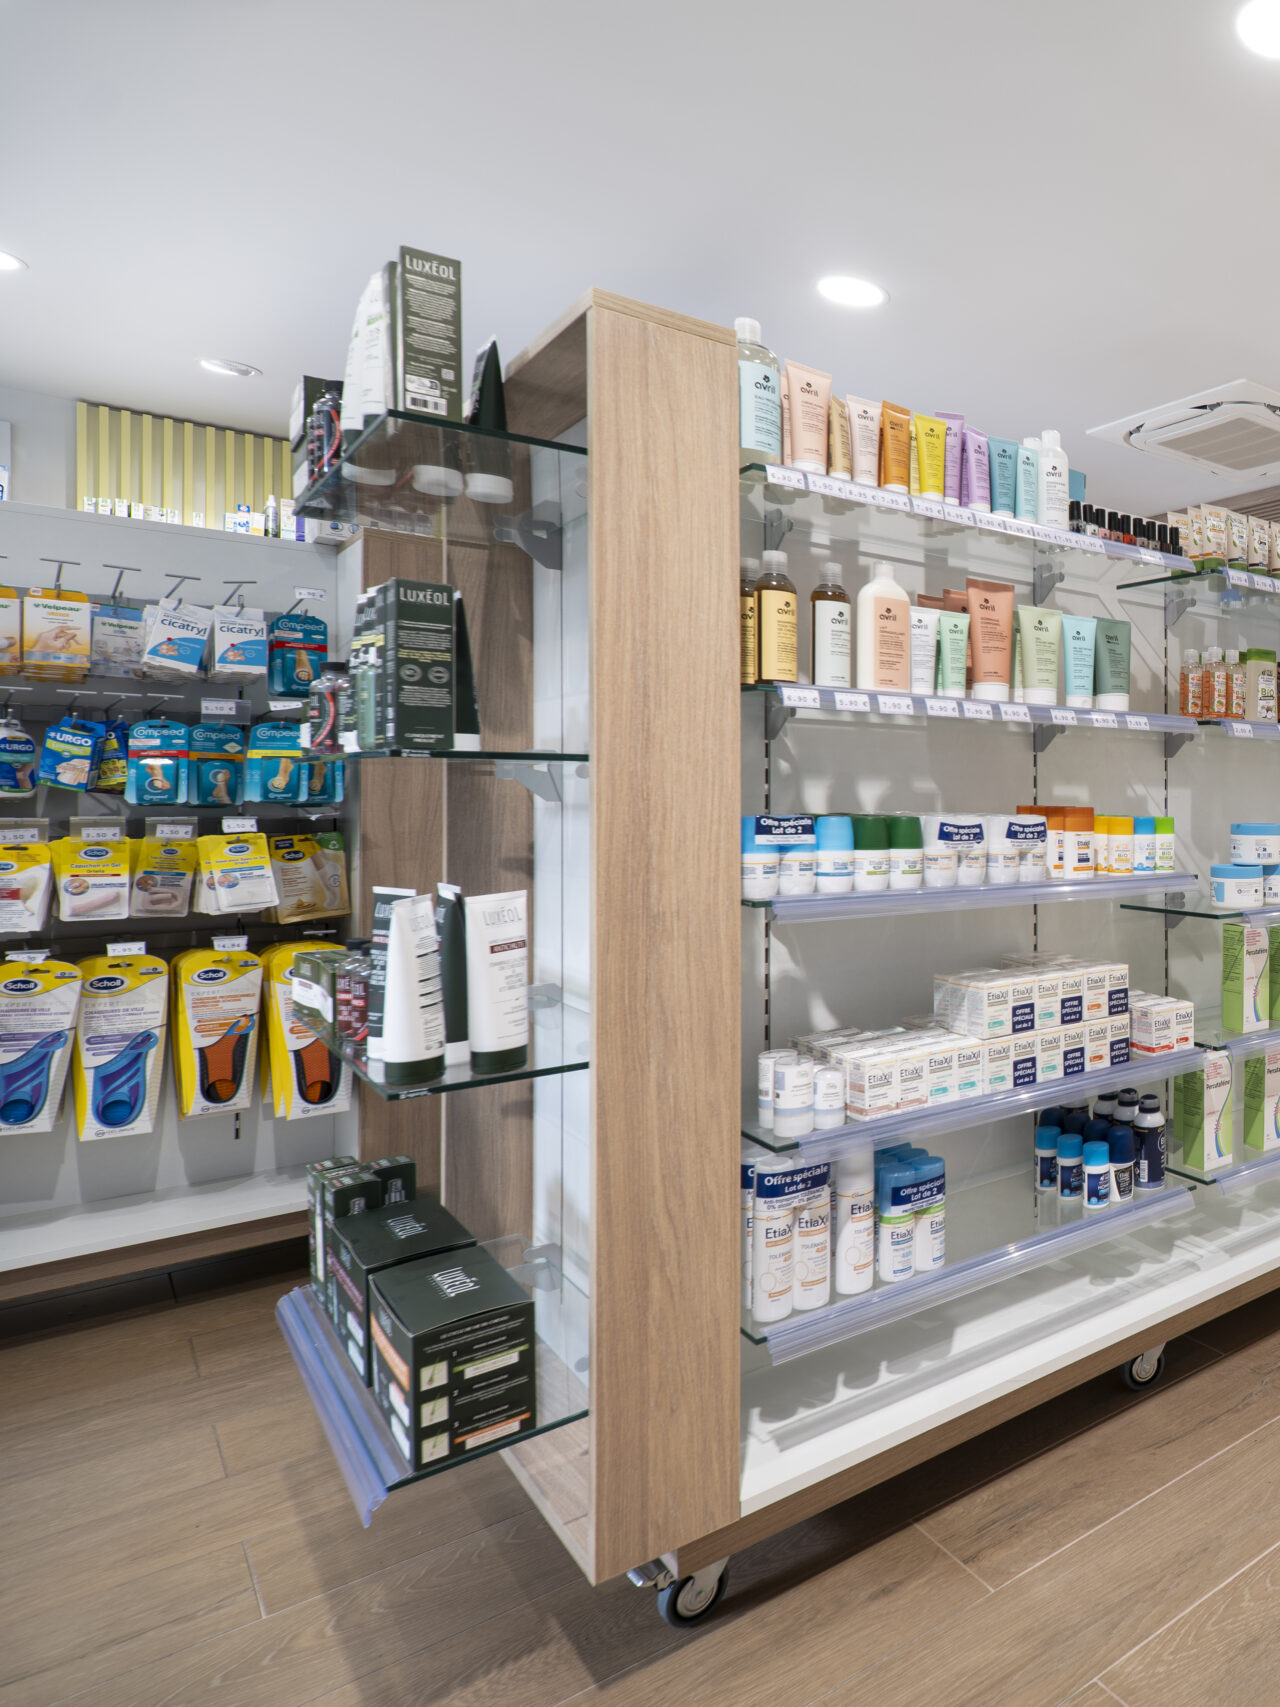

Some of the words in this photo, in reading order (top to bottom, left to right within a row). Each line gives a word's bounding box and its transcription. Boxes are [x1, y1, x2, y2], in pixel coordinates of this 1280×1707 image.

[405, 254, 456, 281] LUXÉOL
[754, 380, 776, 395] avril
[800, 386, 819, 398] avril
[857, 413, 874, 422] avril
[924, 431, 940, 440] avril
[1046, 470, 1062, 478] avril
[400, 587, 451, 606] LUXÉOL
[777, 607, 795, 617] avril
[979, 603, 996, 612] avril
[831, 617, 848, 626] avril
[879, 613, 897, 622] avril
[160, 618, 208, 637] cicatryl
[278, 618, 325, 632] Compeed
[912, 622, 928, 630] avril
[1033, 624, 1050, 632] avril
[219, 624, 265, 637] cicatryl
[949, 627, 964, 635] avril
[1072, 634, 1086, 642] avril
[133, 726, 185, 739] Compeed
[193, 729, 240, 741] Compeed
[56, 732, 92, 746] URGO
[760, 817, 779, 826] Offre
[780, 817, 812, 828] spéciale
[772, 826, 784, 834] Lot
[284, 852, 303, 861] Scholl
[199, 971, 225, 980] Scholl
[6, 982, 35, 990] Scholl
[91, 978, 122, 988] Scholl
[1017, 1062, 1032, 1070] OFFRE
[764, 1175, 792, 1186] Offre
[793, 1165, 829, 1182] spéciale
[784, 1185, 797, 1193] Lot
[765, 1223, 793, 1240] EtiaX
